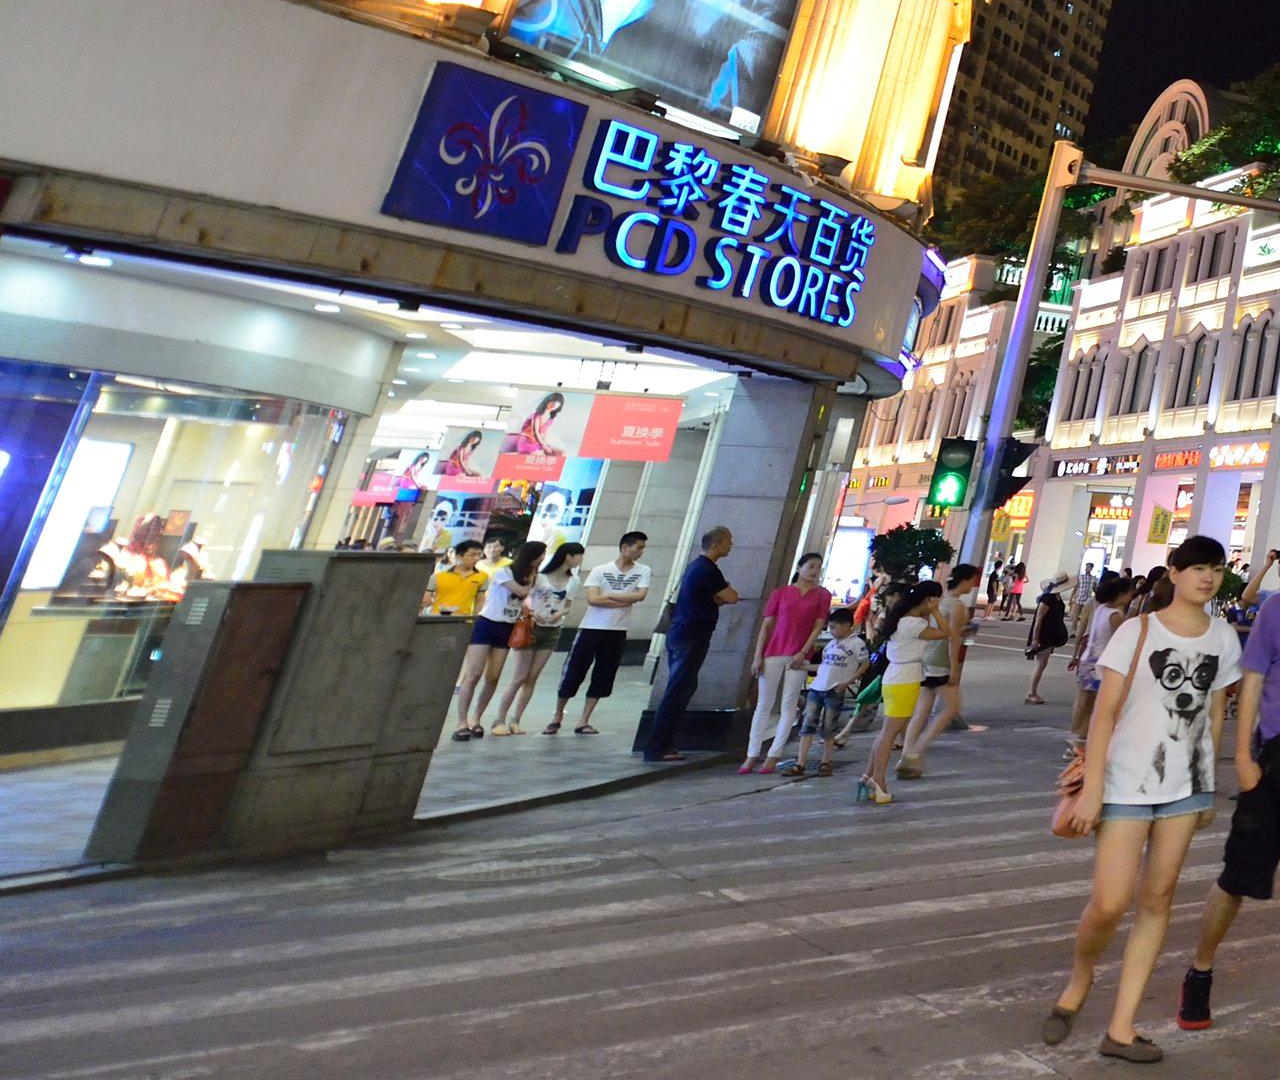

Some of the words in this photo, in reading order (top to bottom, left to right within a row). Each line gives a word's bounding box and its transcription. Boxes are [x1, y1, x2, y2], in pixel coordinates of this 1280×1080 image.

[555, 194, 697, 276] PCD
[704, 235, 862, 329] STORES
[590, 118, 877, 283] 巴黎春天百货
